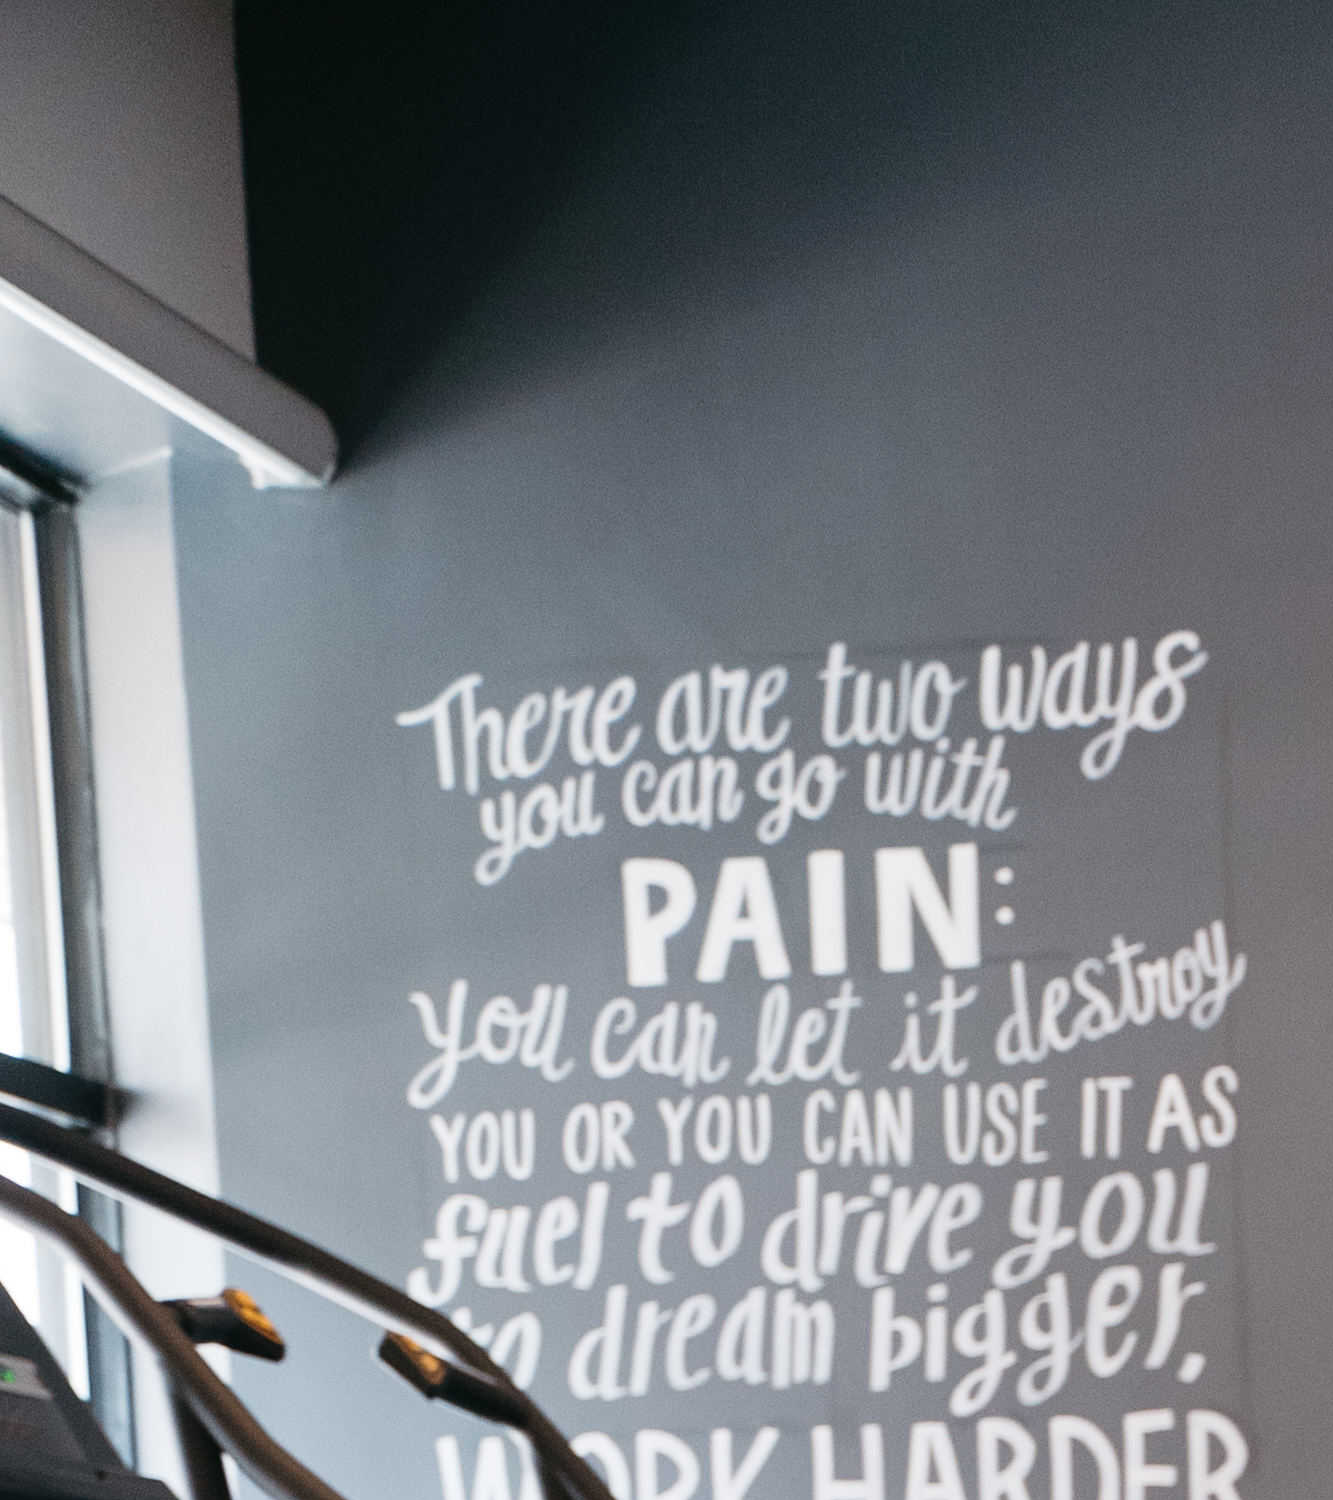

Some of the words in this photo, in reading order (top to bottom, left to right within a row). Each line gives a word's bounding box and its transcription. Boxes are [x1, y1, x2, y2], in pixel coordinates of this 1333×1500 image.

[397, 673, 640, 794] There
[656, 660, 792, 758] are
[818, 641, 966, 748] two
[979, 629, 1208, 781] ways
[473, 770, 605, 886] you
[620, 745, 743, 831] can
[754, 745, 845, 845] go
[864, 733, 1017, 833] with
[620, 842, 1015, 987] PAIN:
[590, 993, 729, 1087] can
[747, 982, 864, 1087] let
[890, 972, 979, 1078] it
[996, 908, 1247, 1065] destroy
[427, 1105, 536, 1185] YOU
[562, 1101, 636, 1174] OR
[657, 1095, 772, 1167] YOU
[804, 1085, 913, 1165] CAN
[943, 1078, 1049, 1165] USE
[1080, 1075, 1133, 1160] IT
[1147, 1064, 1237, 1156] AS
[406, 1181, 610, 1305] fuel
[625, 1171, 744, 1287] to
[760, 1167, 982, 1293] drive
[992, 1161, 1216, 1290] you
[567, 1281, 836, 1402] dream
